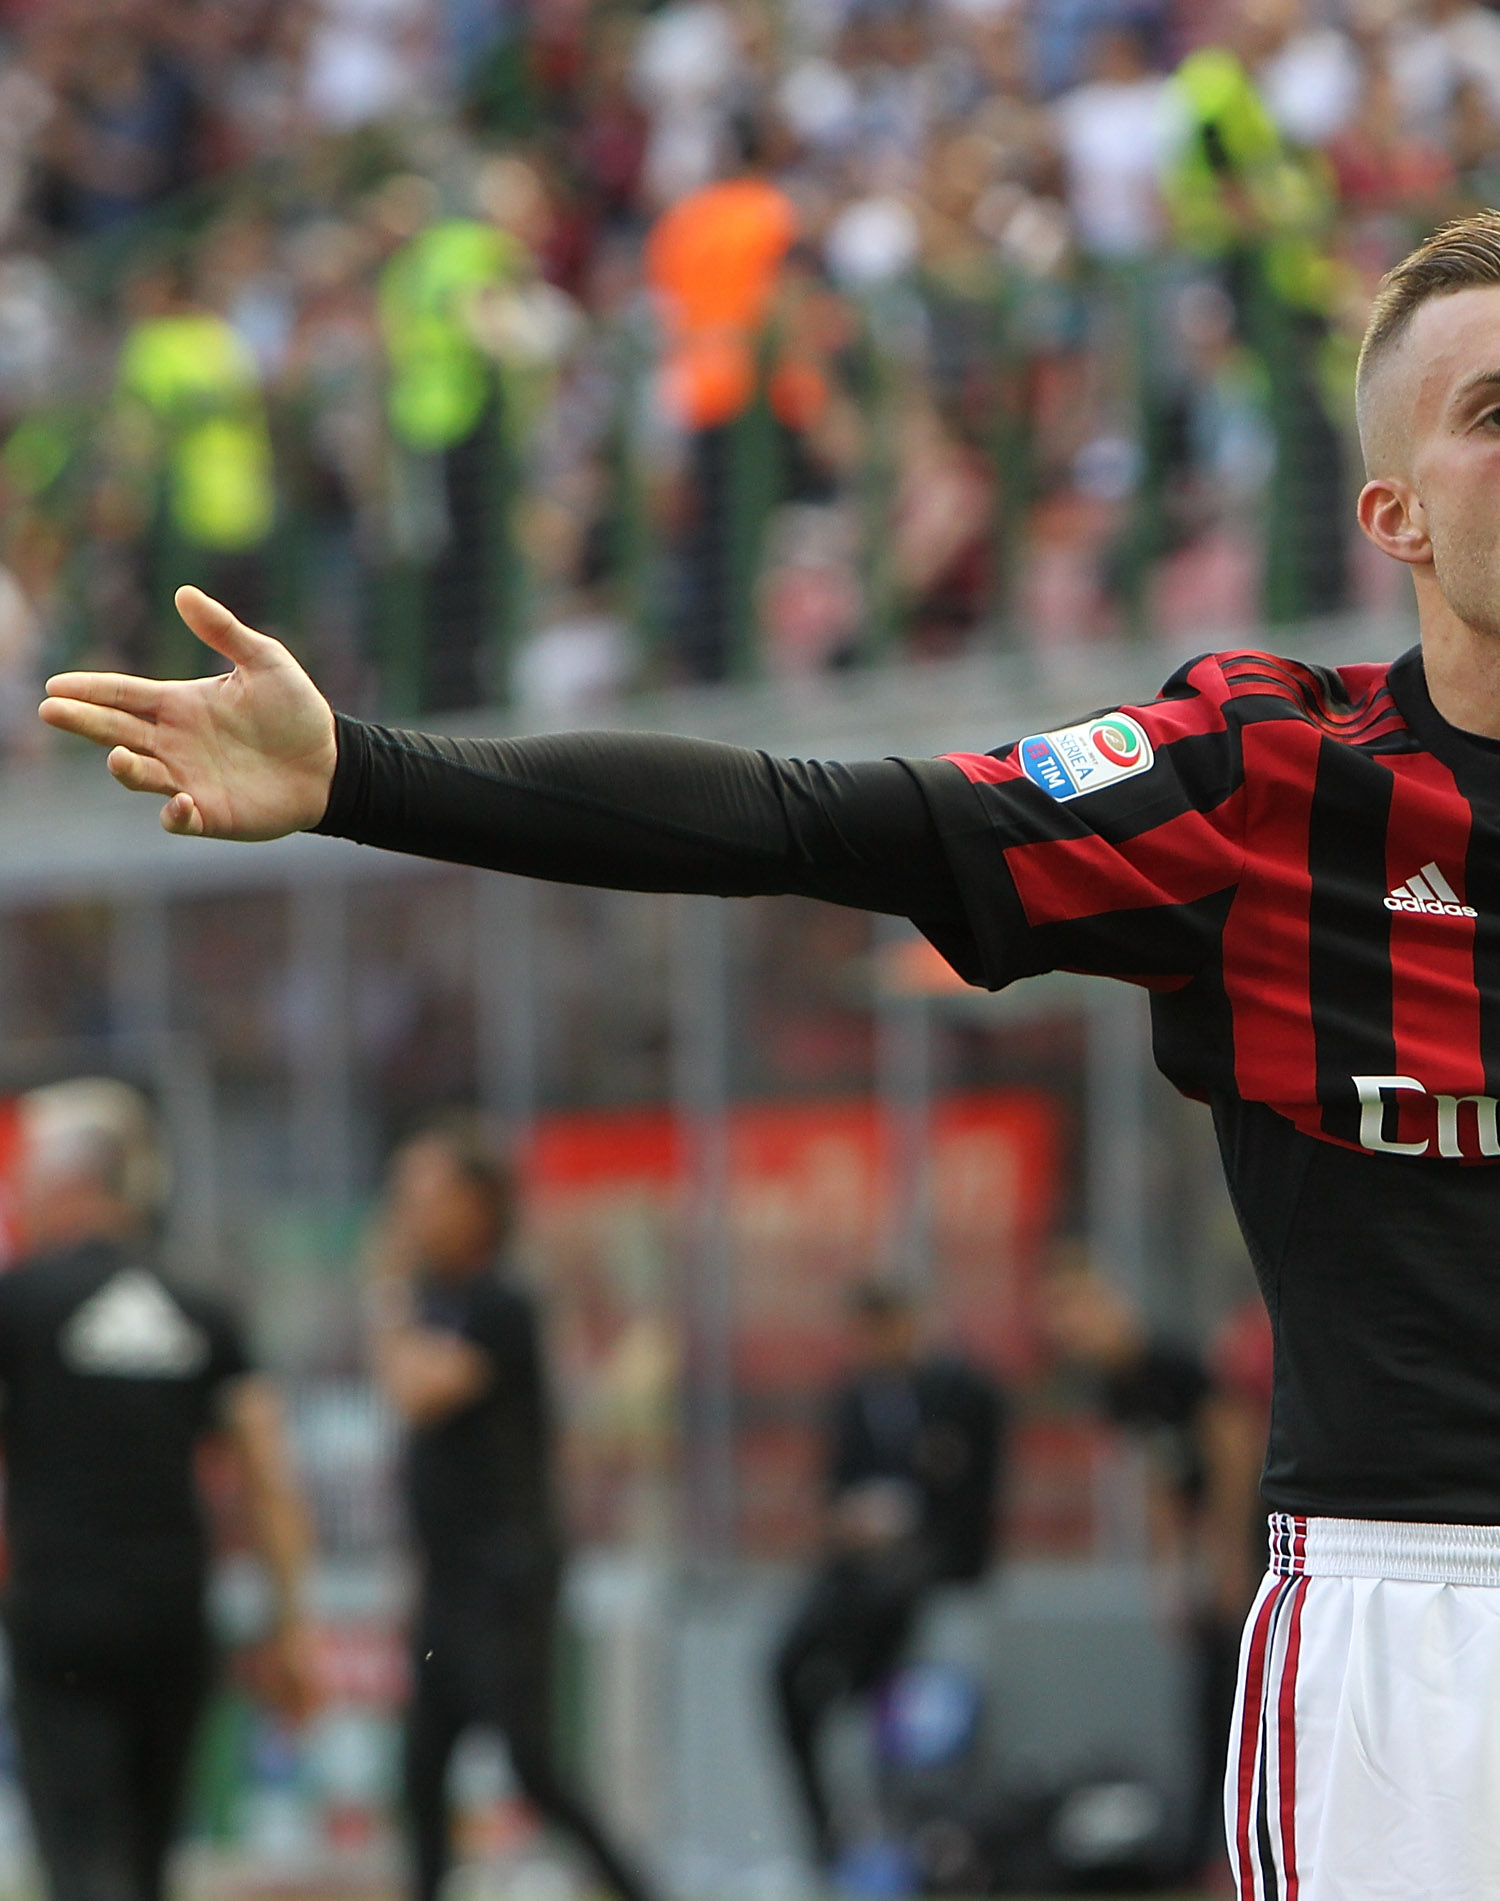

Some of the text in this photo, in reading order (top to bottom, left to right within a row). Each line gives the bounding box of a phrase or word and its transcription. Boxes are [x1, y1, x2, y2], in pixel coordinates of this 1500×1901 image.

[1037, 756, 1066, 789] TIM
[1056, 733, 1087, 767] SERIE
[1076, 768, 1094, 780] A
[1383, 895, 1479, 918] adidas
